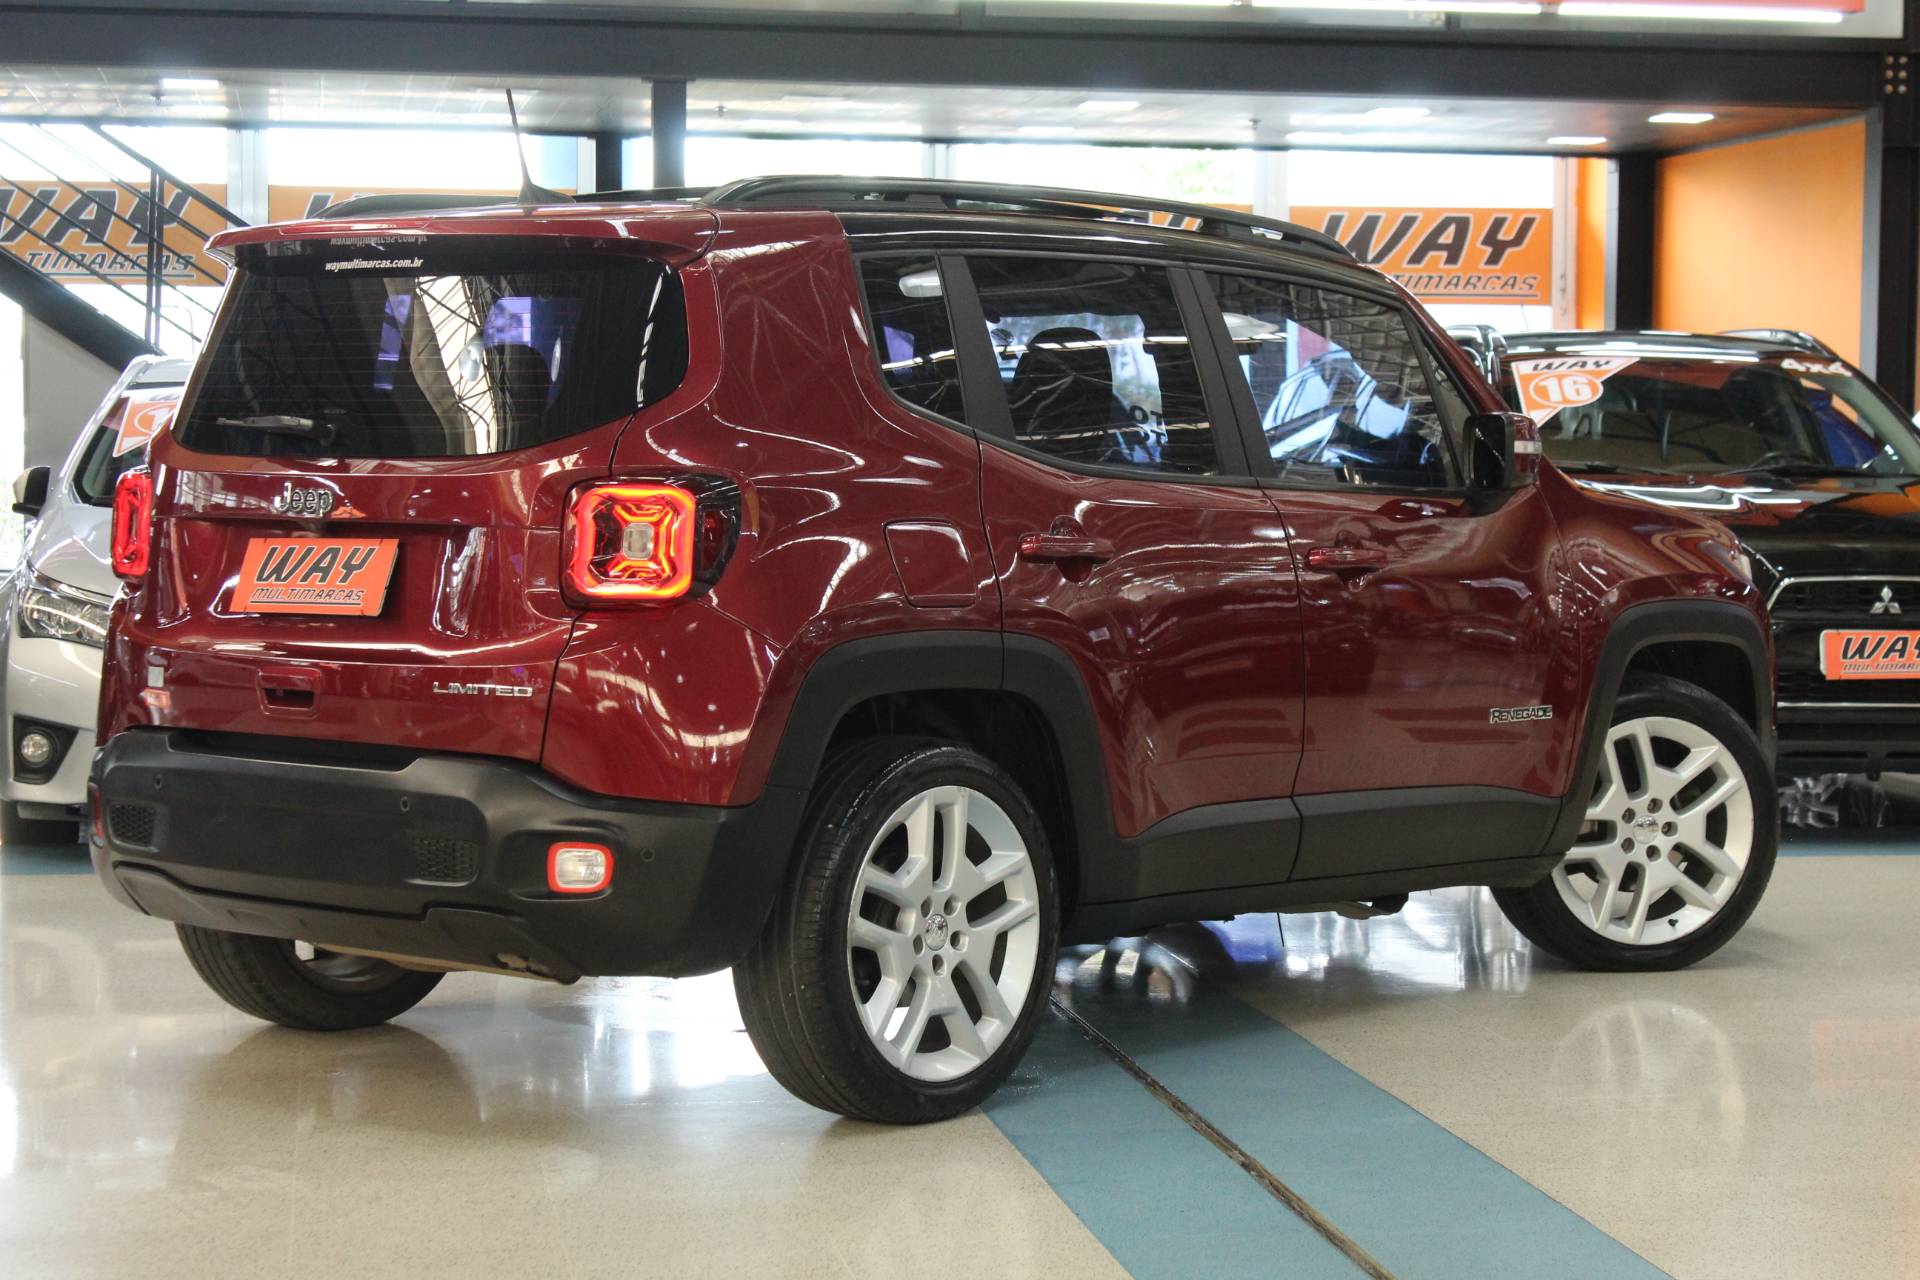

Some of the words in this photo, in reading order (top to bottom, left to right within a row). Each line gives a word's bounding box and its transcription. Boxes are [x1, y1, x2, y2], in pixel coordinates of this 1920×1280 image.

[1321, 212, 1541, 268] WAY
[325, 257, 424, 272] waymultimarcas.com.br
[1391, 273, 1539, 291] TIMARCAS
[1536, 375, 1593, 402] 16
[274, 482, 332, 517] Jeep
[255, 546, 377, 584] WAY
[250, 587, 366, 601] MULTIMARCAS
[1841, 635, 1920, 661] WA
[433, 682, 533, 697] LIMITED
[1489, 705, 1553, 724] RENEGADE
